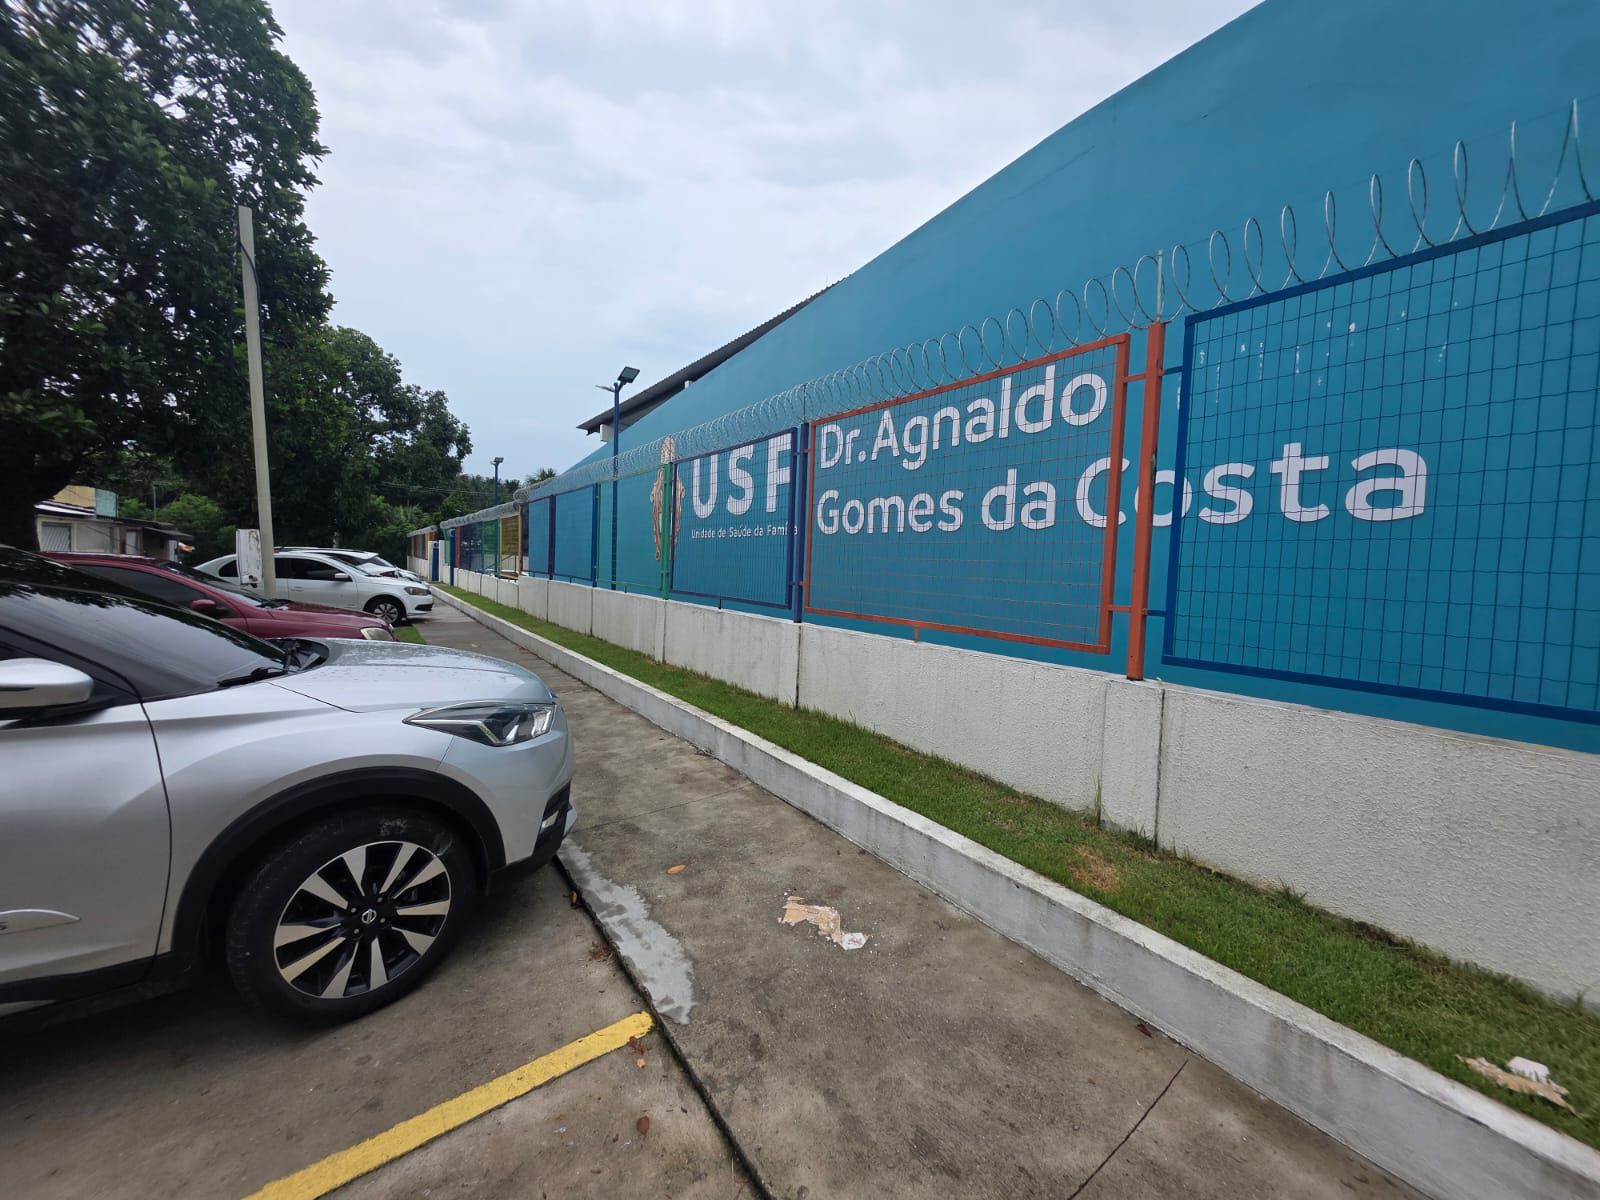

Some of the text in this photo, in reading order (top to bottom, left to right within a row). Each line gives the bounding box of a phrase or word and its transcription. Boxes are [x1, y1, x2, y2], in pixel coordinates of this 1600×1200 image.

[692, 432, 792, 518] USF
[817, 442, 1427, 535] Gomes da Costa
[717, 528, 727, 538] de
[729, 523, 752, 538] Saúde
[754, 524, 764, 537] da
[767, 521, 798, 536] Famía
